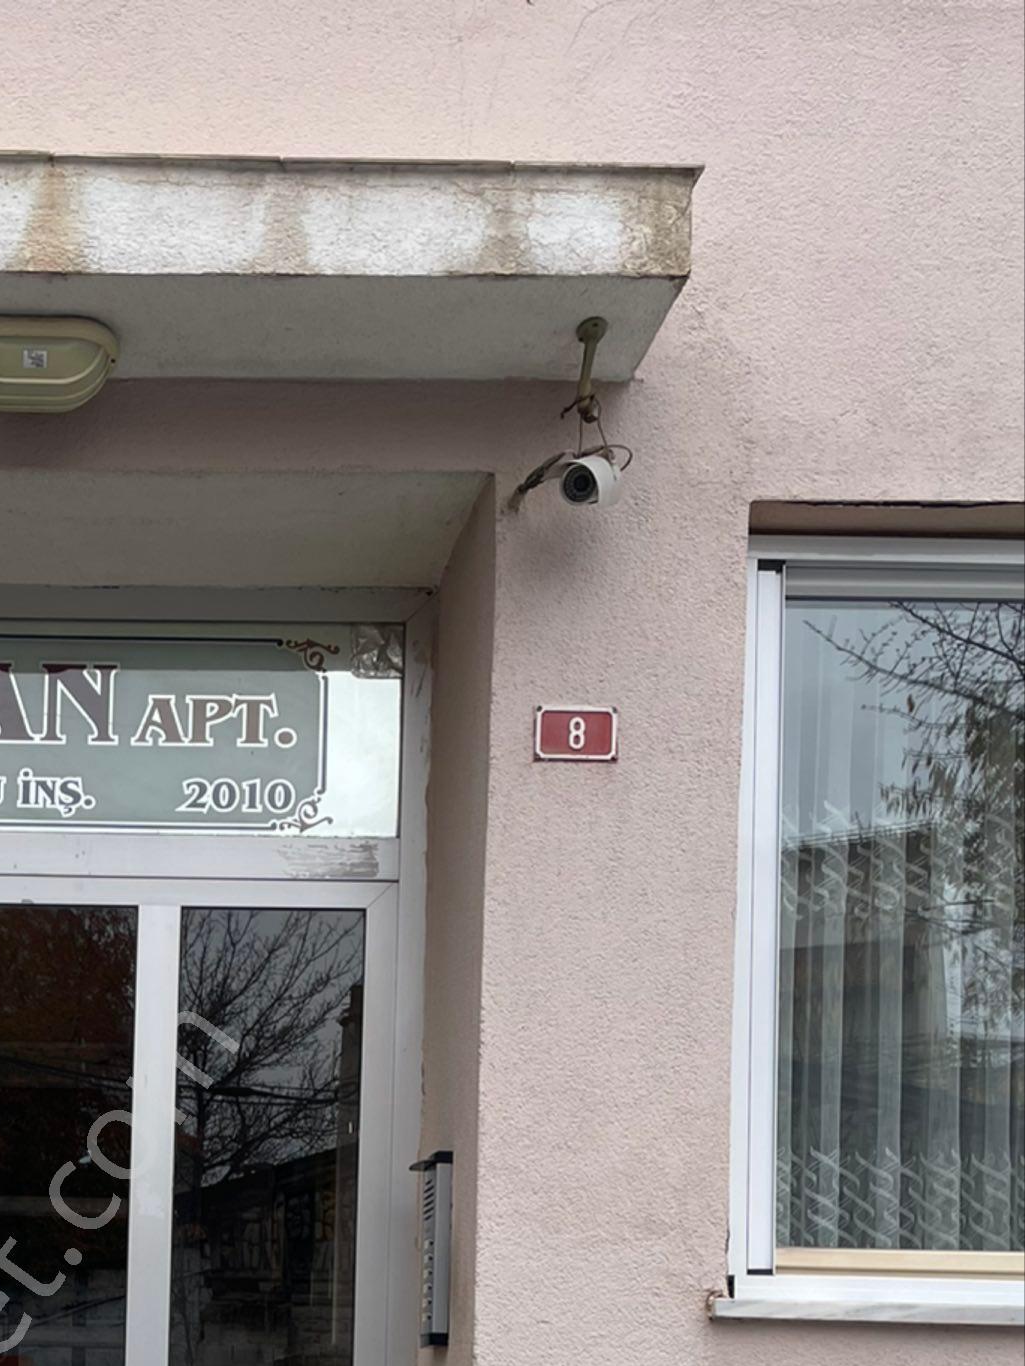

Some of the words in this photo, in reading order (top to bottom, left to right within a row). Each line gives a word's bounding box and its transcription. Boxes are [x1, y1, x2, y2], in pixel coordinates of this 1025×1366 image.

[131, 694, 297, 748] APT.
[568, 716, 586, 750] 8
[176, 778, 296, 813] 2010
